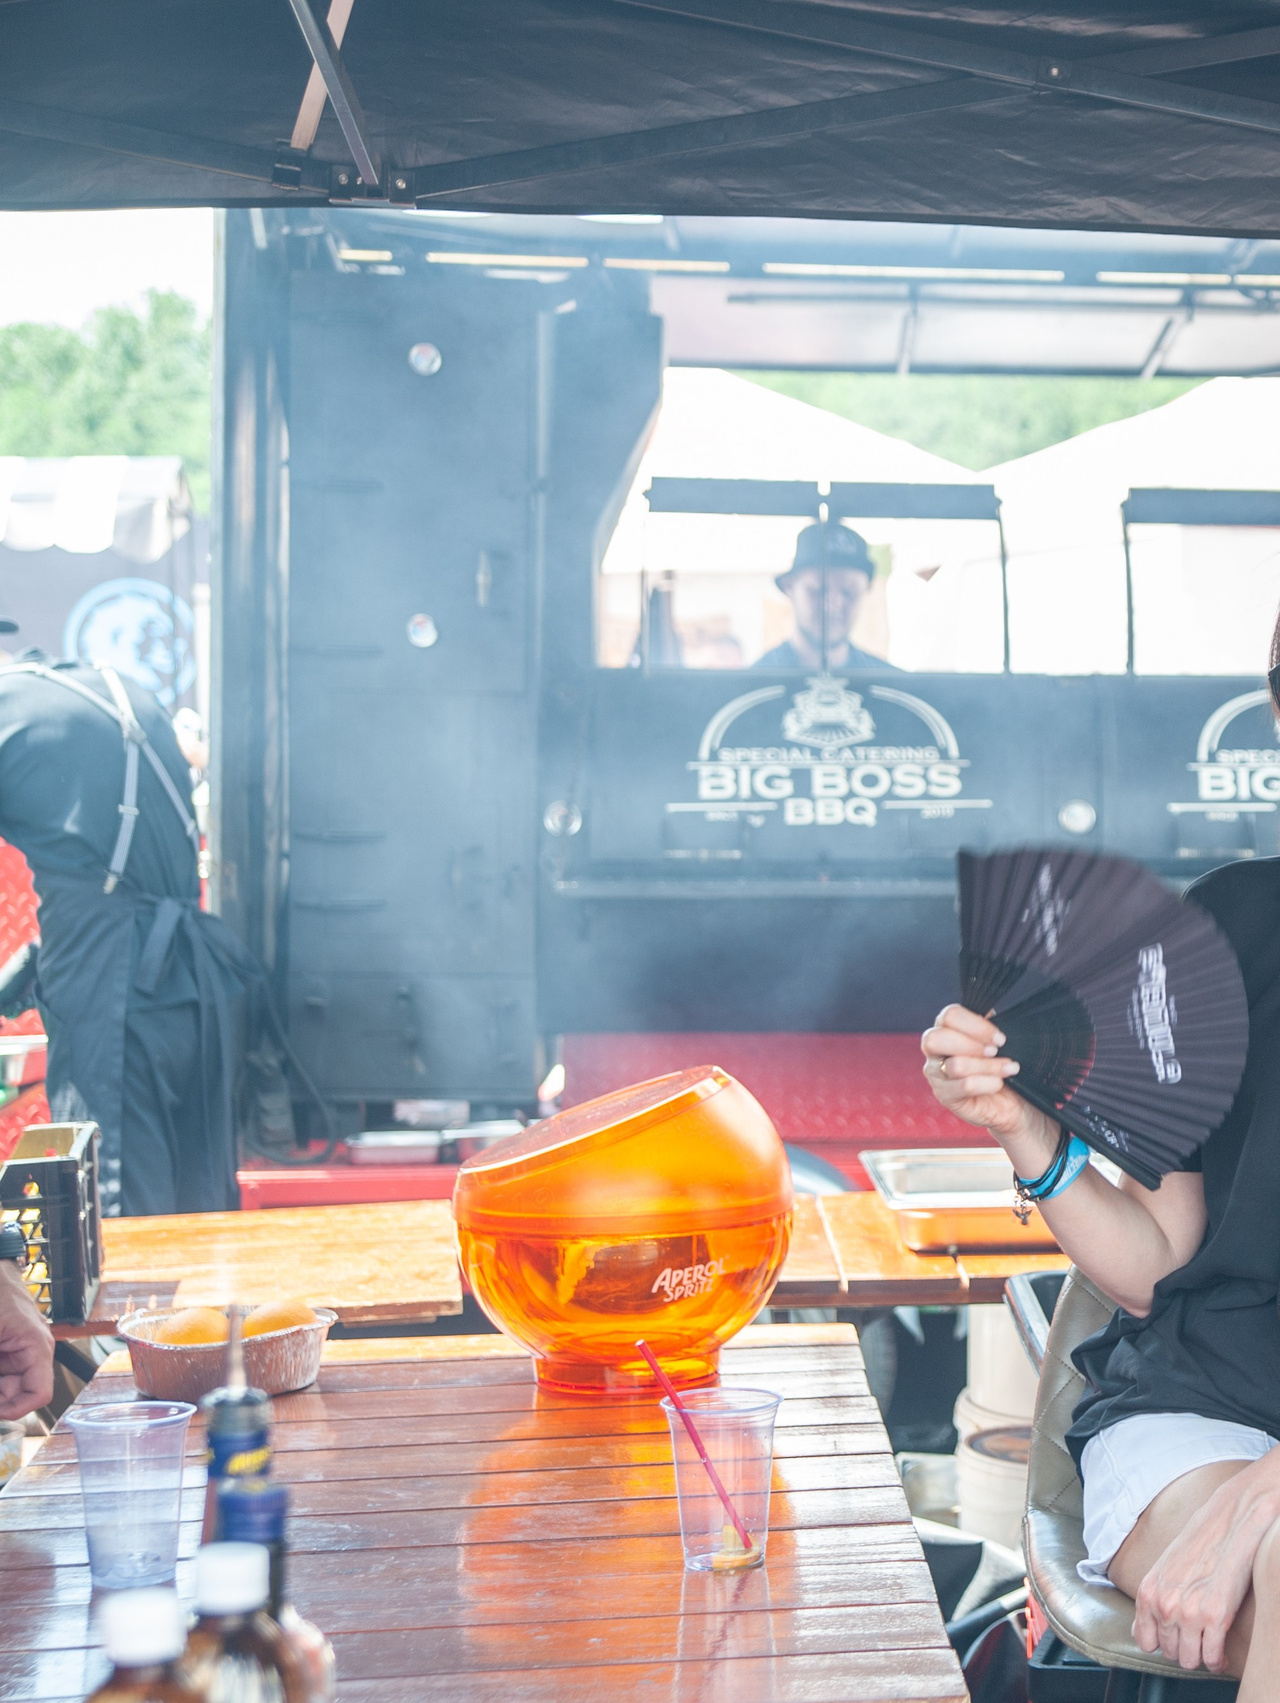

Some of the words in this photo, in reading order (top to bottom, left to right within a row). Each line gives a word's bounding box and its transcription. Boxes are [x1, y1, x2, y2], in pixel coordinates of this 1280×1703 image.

[718, 746, 818, 763] SPECIAL
[820, 746, 941, 763] CATERING
[698, 764, 795, 800] BIG
[811, 762, 963, 799] BOSS
[784, 797, 878, 827] BBQ
[651, 1258, 727, 1293] APEROL
